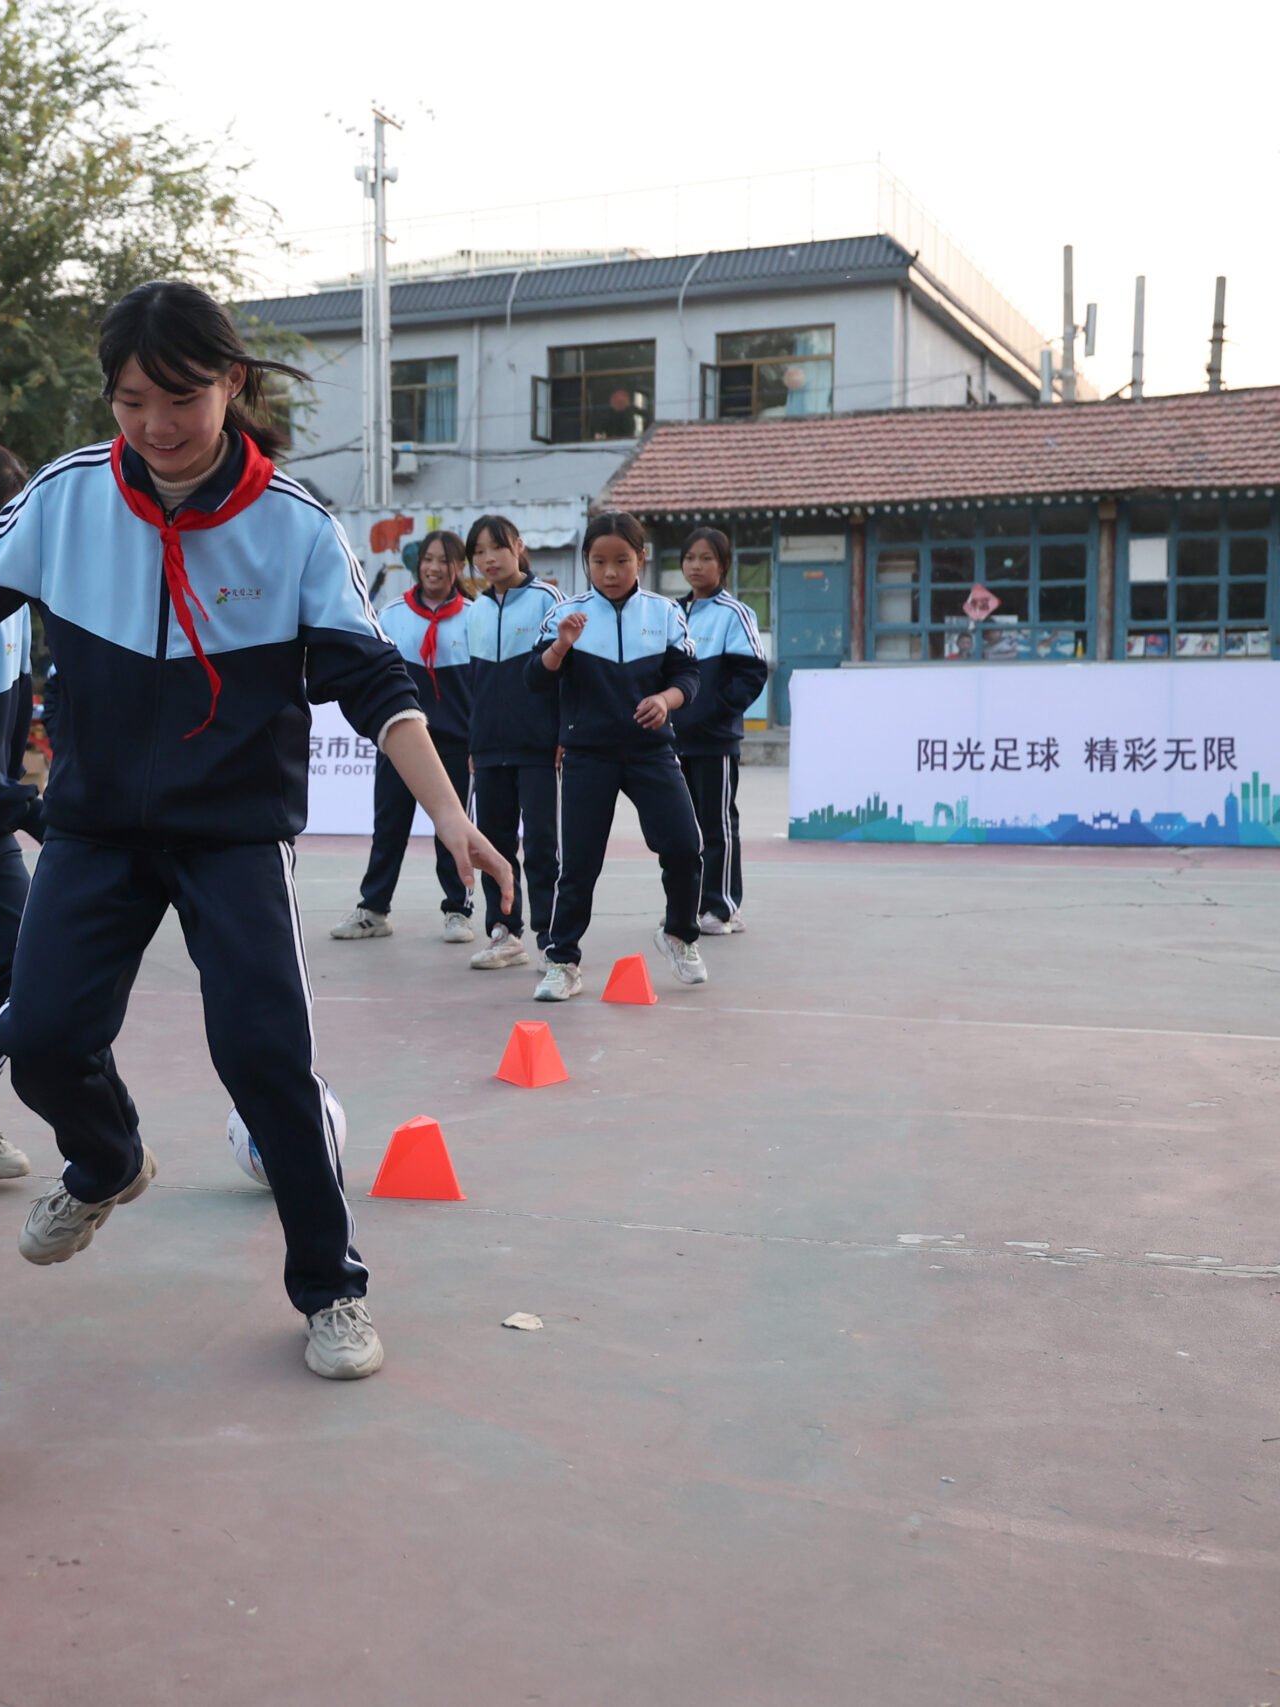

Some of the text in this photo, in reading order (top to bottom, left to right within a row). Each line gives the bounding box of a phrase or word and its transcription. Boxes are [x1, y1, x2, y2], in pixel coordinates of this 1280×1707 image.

[917, 737, 1239, 772] 阳光足球 精彩无限
[335, 764, 376, 775] FOOT
